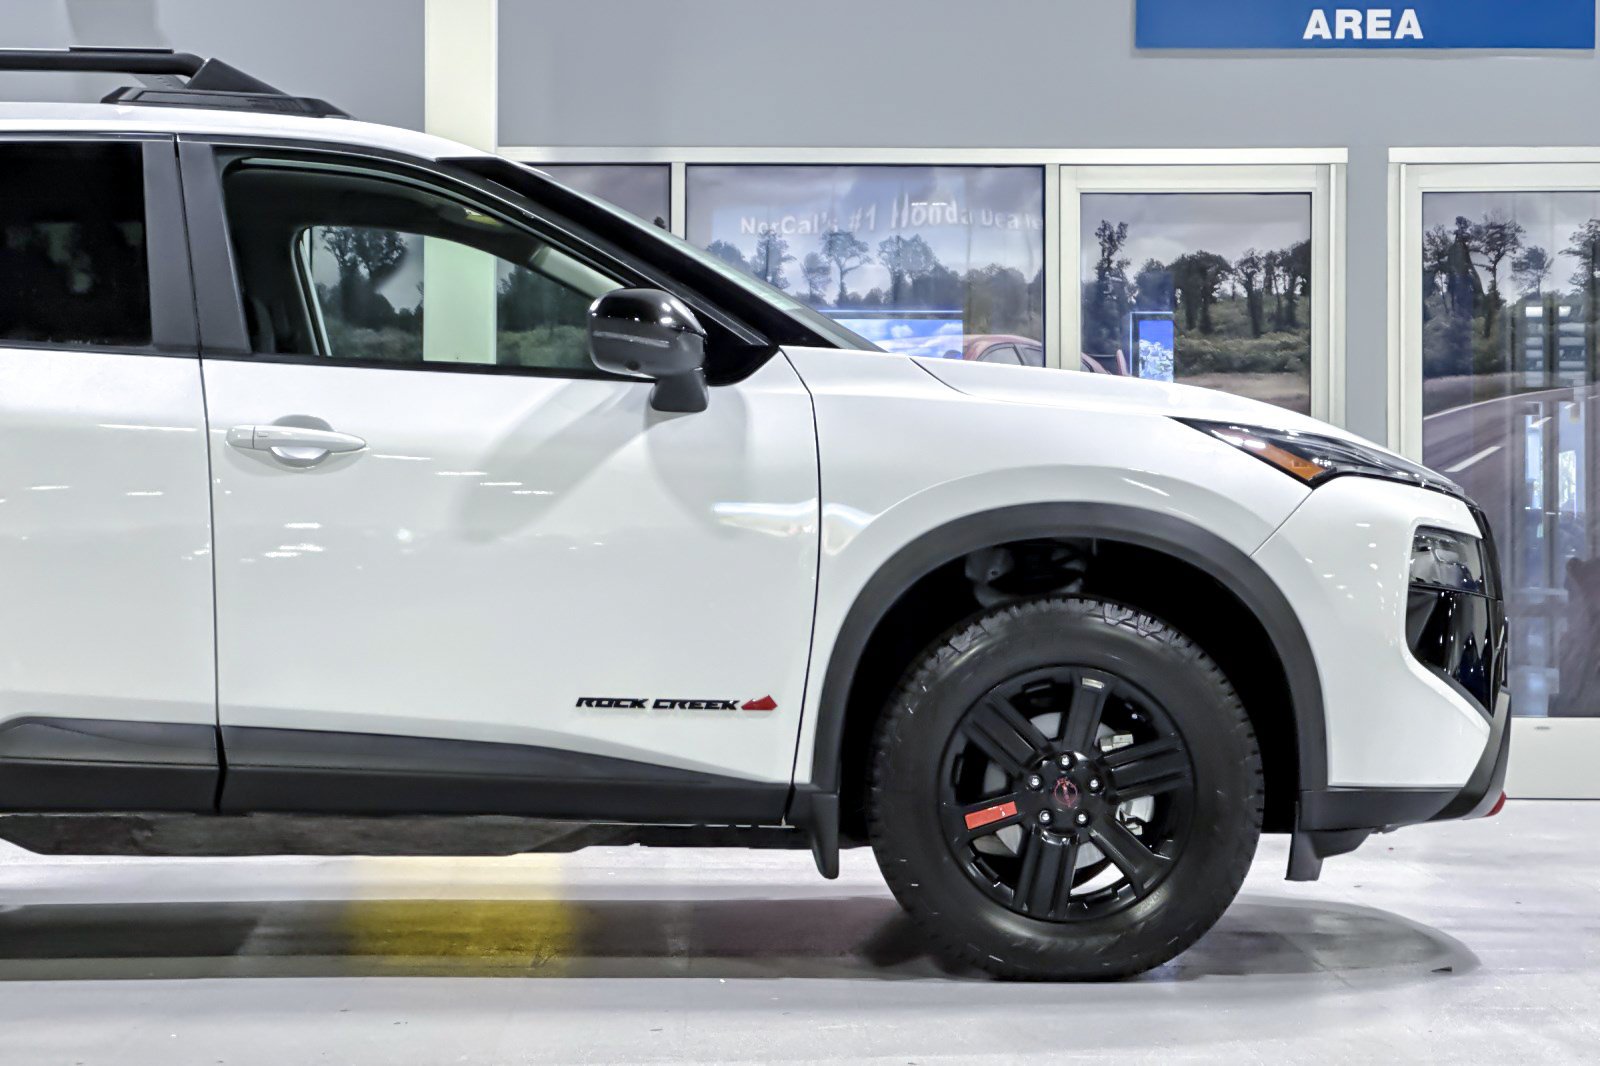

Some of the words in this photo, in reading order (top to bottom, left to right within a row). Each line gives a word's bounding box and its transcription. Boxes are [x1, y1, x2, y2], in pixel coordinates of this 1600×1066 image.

[1302, 8, 1424, 39] AREA
[848, 203, 877, 233] #1
[890, 192, 973, 229] Honda
[576, 697, 649, 709] ROCK
[652, 699, 740, 710] CREEK
